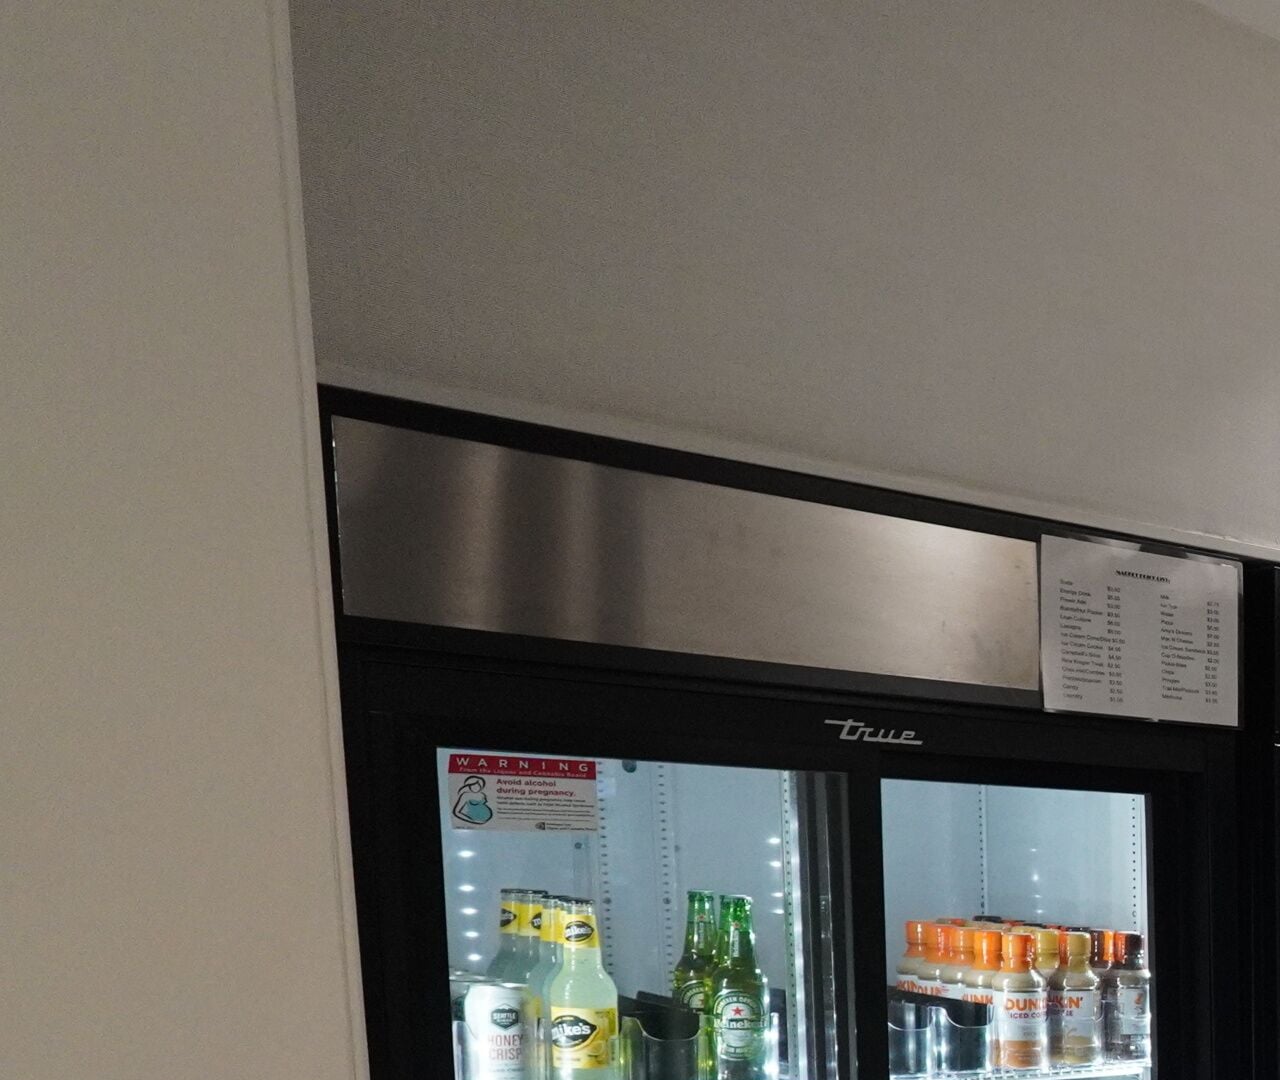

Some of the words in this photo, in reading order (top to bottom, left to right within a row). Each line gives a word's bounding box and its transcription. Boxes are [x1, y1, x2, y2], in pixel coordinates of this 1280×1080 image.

[824, 718, 924, 747] true
[456, 757, 589, 772] WARNING
[496, 778, 523, 787] Avoid
[524, 779, 556, 788] alcohol
[496, 787, 526, 796] during
[528, 787, 576, 798] pregnancy.
[551, 1019, 592, 1036] mike's
[488, 1033, 524, 1047] HONEY
[488, 1047, 522, 1061] CRISP
